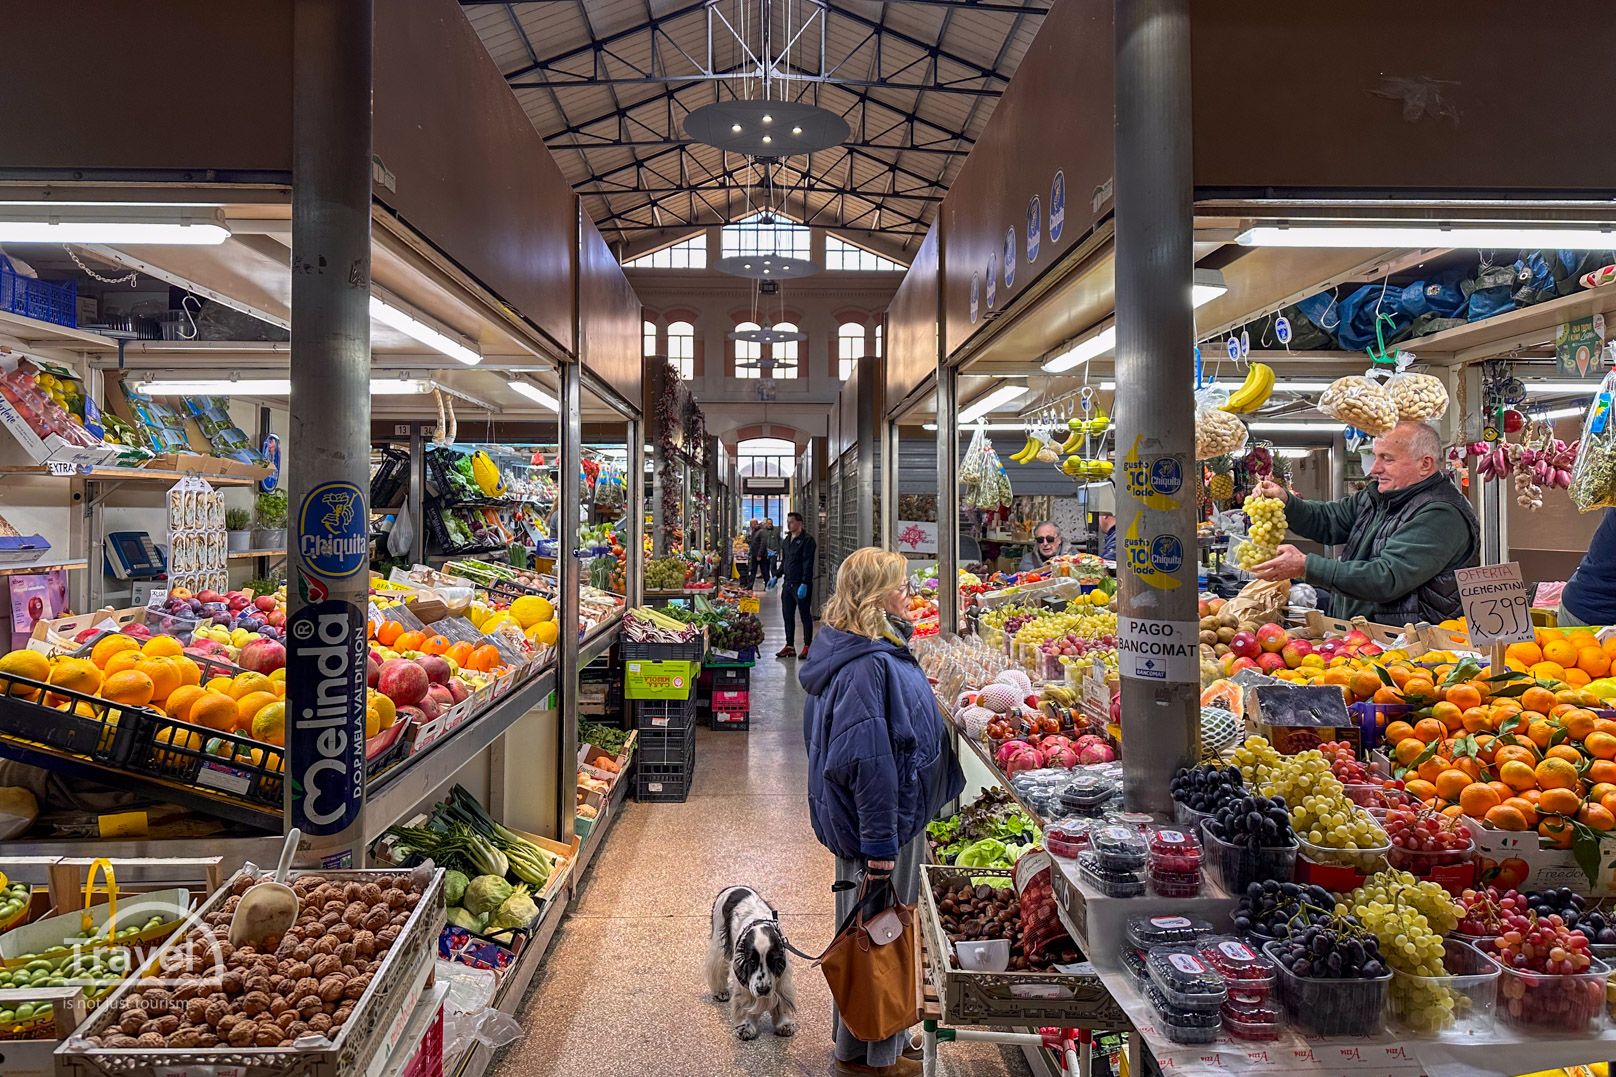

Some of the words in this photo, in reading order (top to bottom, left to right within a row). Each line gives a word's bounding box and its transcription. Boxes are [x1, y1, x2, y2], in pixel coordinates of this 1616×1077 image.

[399, 425, 407, 434] 13
[50, 462, 75, 474] EXTRA
[1123, 459, 1149, 471] gusto
[1129, 470, 1149, 486] 10
[1150, 475, 1181, 489] Chiquita
[1126, 483, 1132, 491] e
[1132, 487, 1154, 497] lode
[301, 533, 366, 562] Chiquita
[1124, 537, 1150, 548] gusto
[1130, 548, 1149, 564] 10
[1151, 553, 1182, 567] Chiquita
[1133, 565, 1155, 575] lode
[1457, 565, 1513, 582] OFFERTA
[1130, 621, 1174, 637] PAGO
[354, 626, 364, 665] NON
[1119, 637, 1197, 657] BANCOMAT
[354, 668, 363, 683] DI
[353, 685, 363, 715] VAL
[353, 716, 363, 756] MELA
[1537, 868, 1584, 879] Freedo
